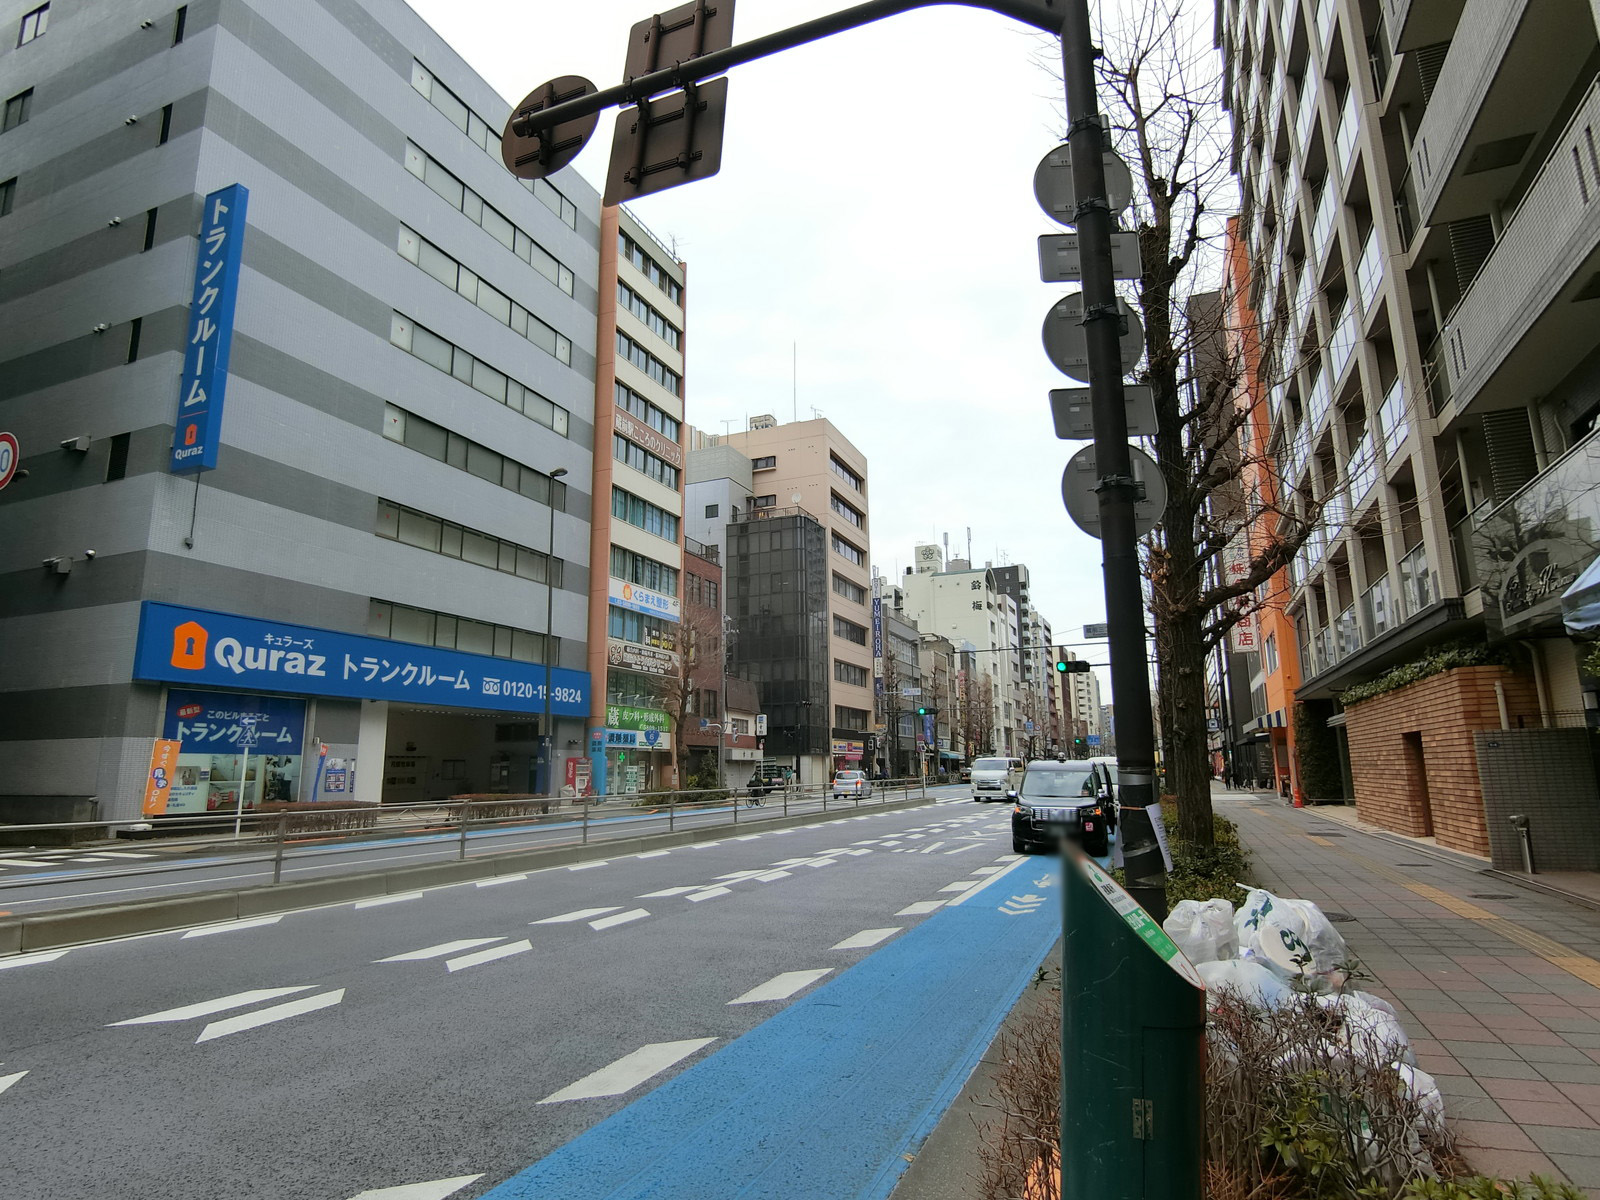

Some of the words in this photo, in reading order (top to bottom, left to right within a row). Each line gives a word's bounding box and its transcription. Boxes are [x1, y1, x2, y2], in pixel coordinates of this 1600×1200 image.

[184, 198, 228, 407] トランクルーム
[0, 448, 10, 473] 0
[175, 445, 203, 461] Quraz
[264, 633, 315, 650] キュラーズ
[873, 599, 882, 657] YUMEIROHA
[214, 637, 326, 677] Quraz
[343, 653, 471, 690] トランクルーム
